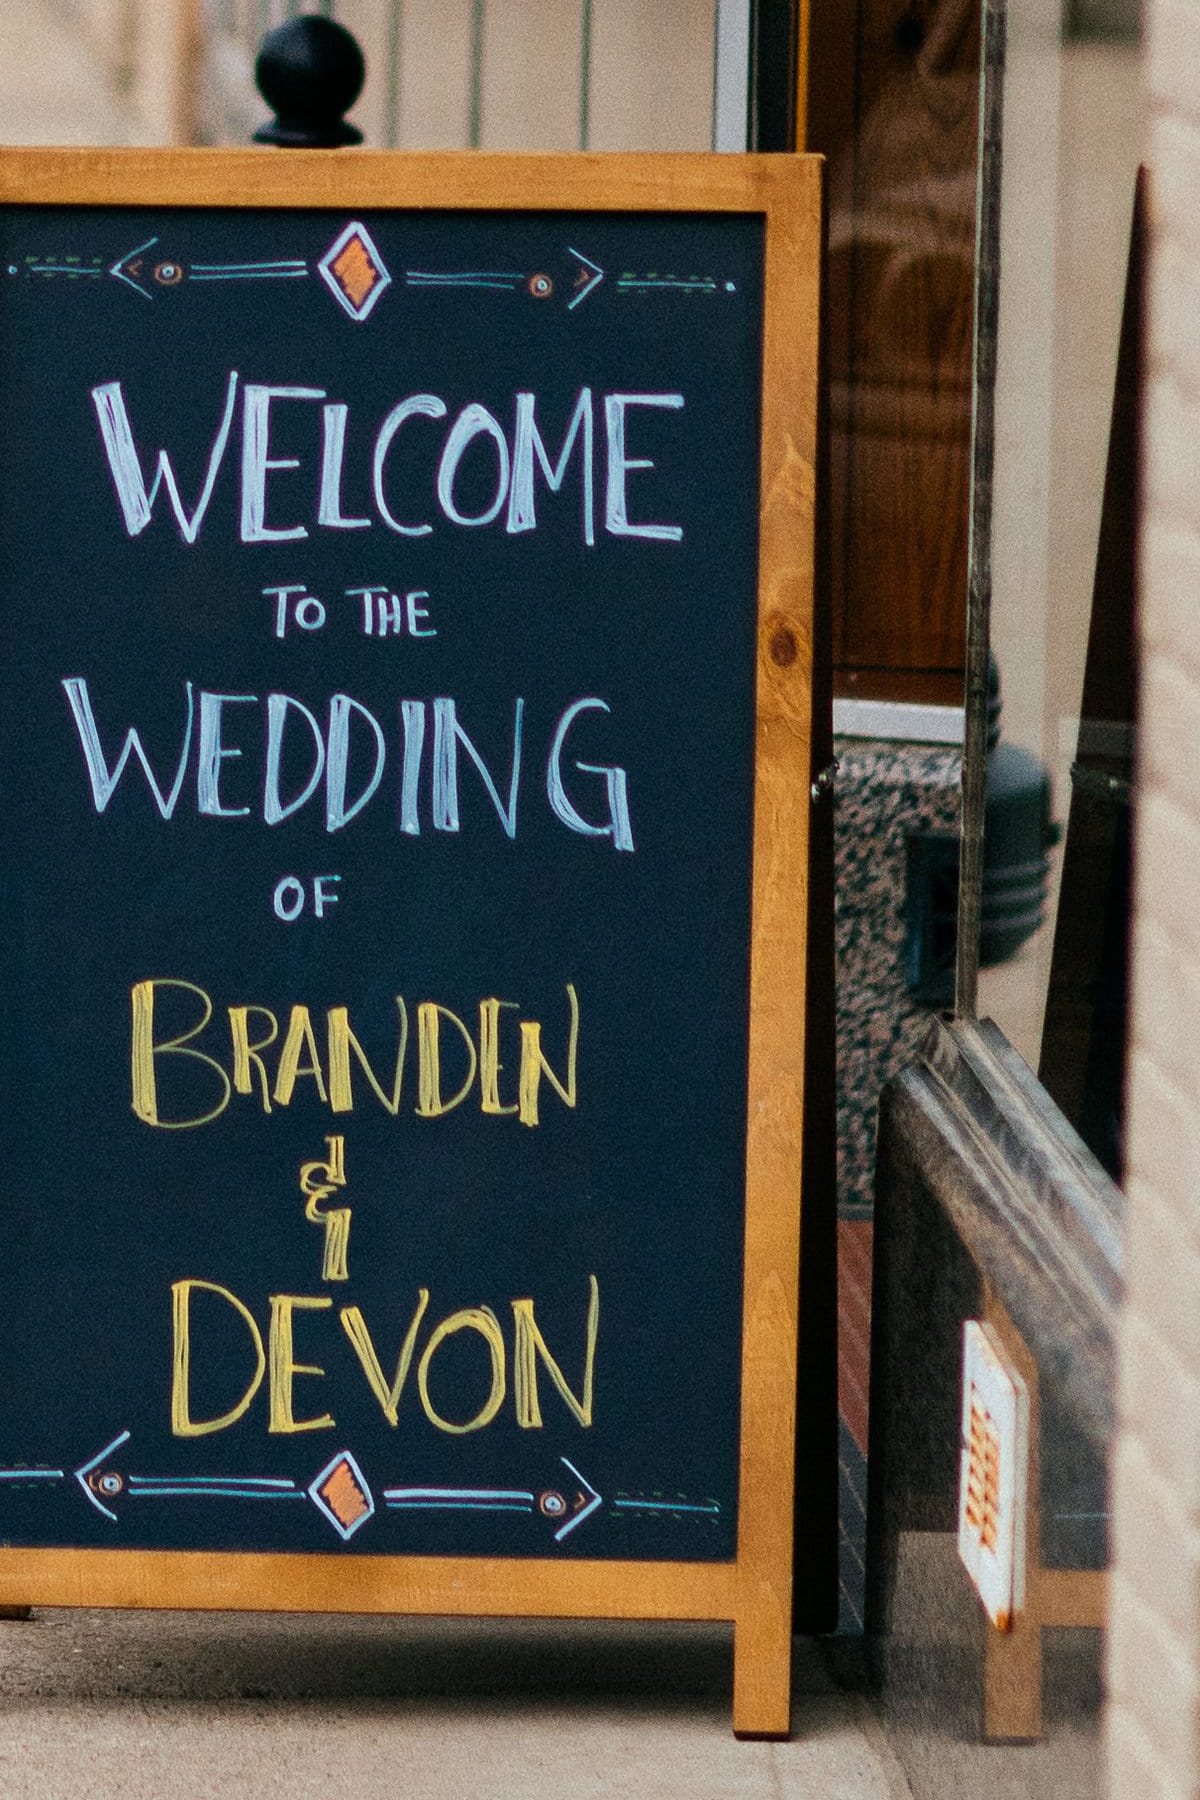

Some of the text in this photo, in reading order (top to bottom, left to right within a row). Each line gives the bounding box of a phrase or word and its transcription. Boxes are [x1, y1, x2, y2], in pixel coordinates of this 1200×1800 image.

[90, 370, 686, 547] WELCOME
[261, 584, 438, 639] TO THE
[60, 676, 636, 853] WEDDING
[273, 874, 343, 922] OF
[130, 978, 580, 1129] BRANDEN
[298, 1134, 353, 1281] &
[169, 1274, 601, 1437] DEVON
